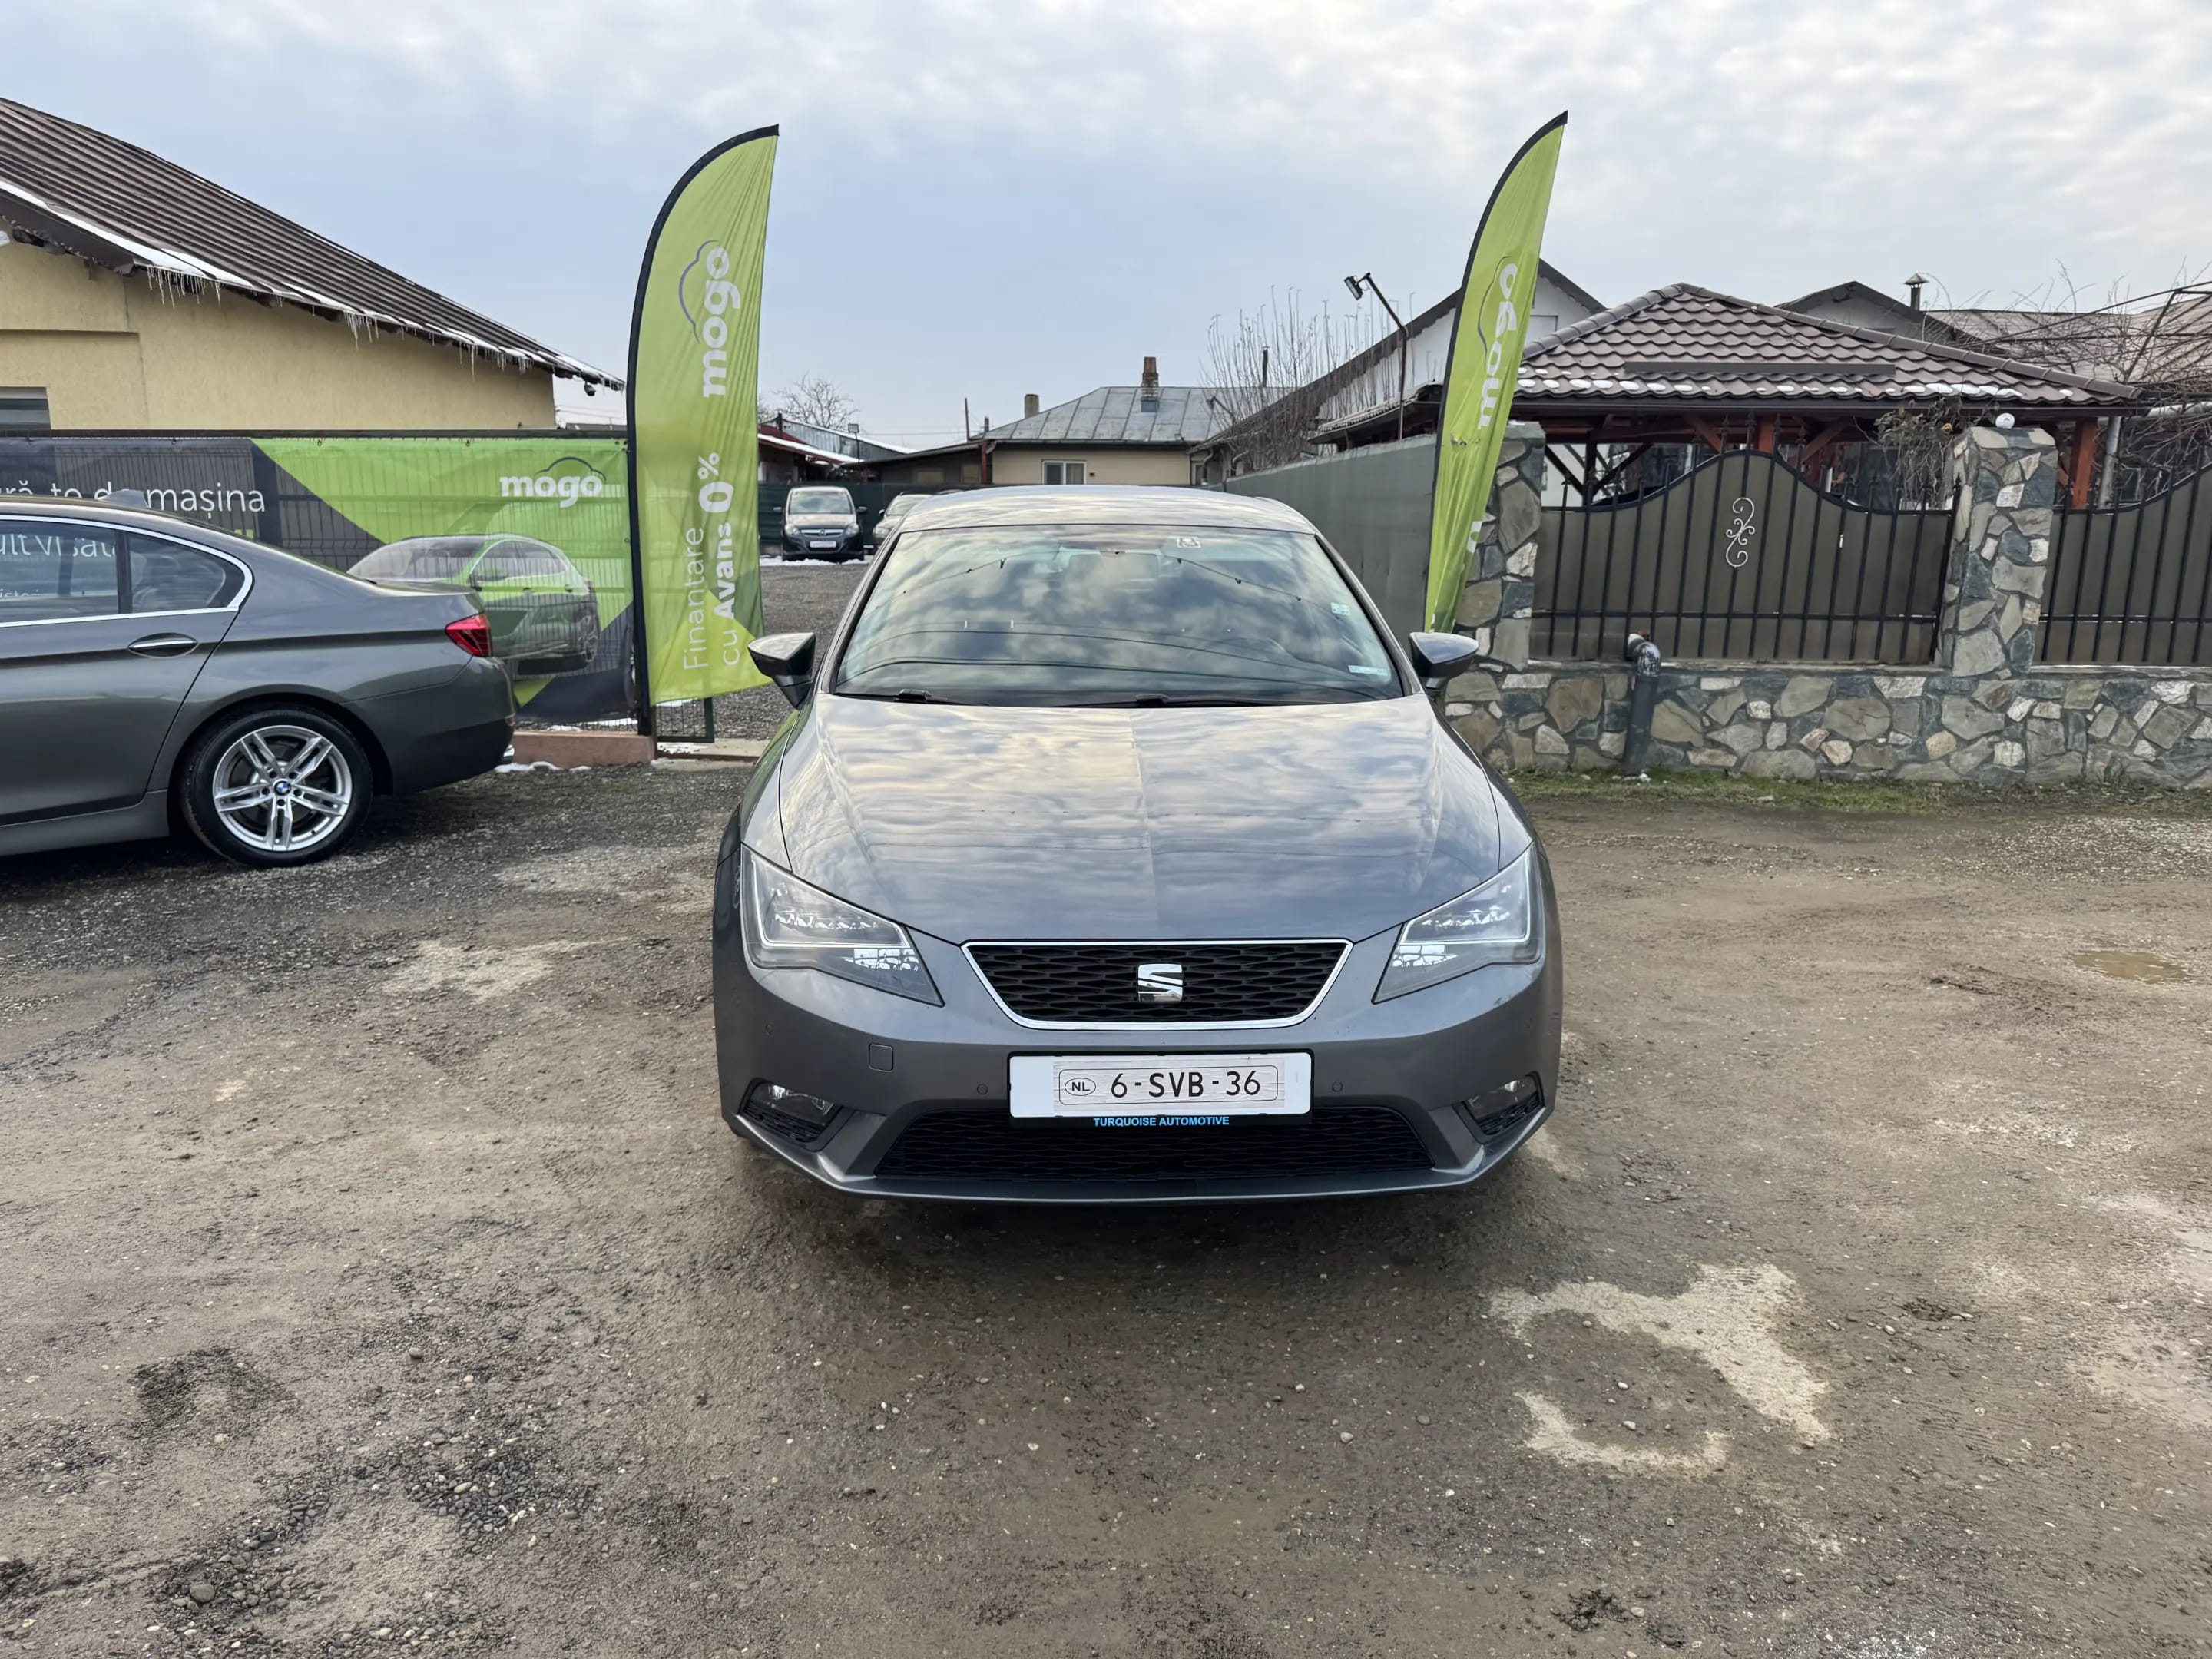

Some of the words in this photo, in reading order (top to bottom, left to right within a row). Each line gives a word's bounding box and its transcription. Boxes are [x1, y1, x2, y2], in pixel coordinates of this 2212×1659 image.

[703, 247, 740, 397] mogo
[147, 482, 266, 518] mașina
[500, 475, 602, 509] mogo
[697, 452, 734, 514] 0%
[714, 522, 736, 620] Avans
[684, 528, 708, 669] Finantare
[723, 629, 740, 666] cu
[1071, 1081, 1091, 1092] NL
[1111, 1070, 1261, 1098] 6-SVB-36
[1093, 1117, 1157, 1128] TURQUOISE
[1159, 1116, 1230, 1127] AUTOMOTIVE
